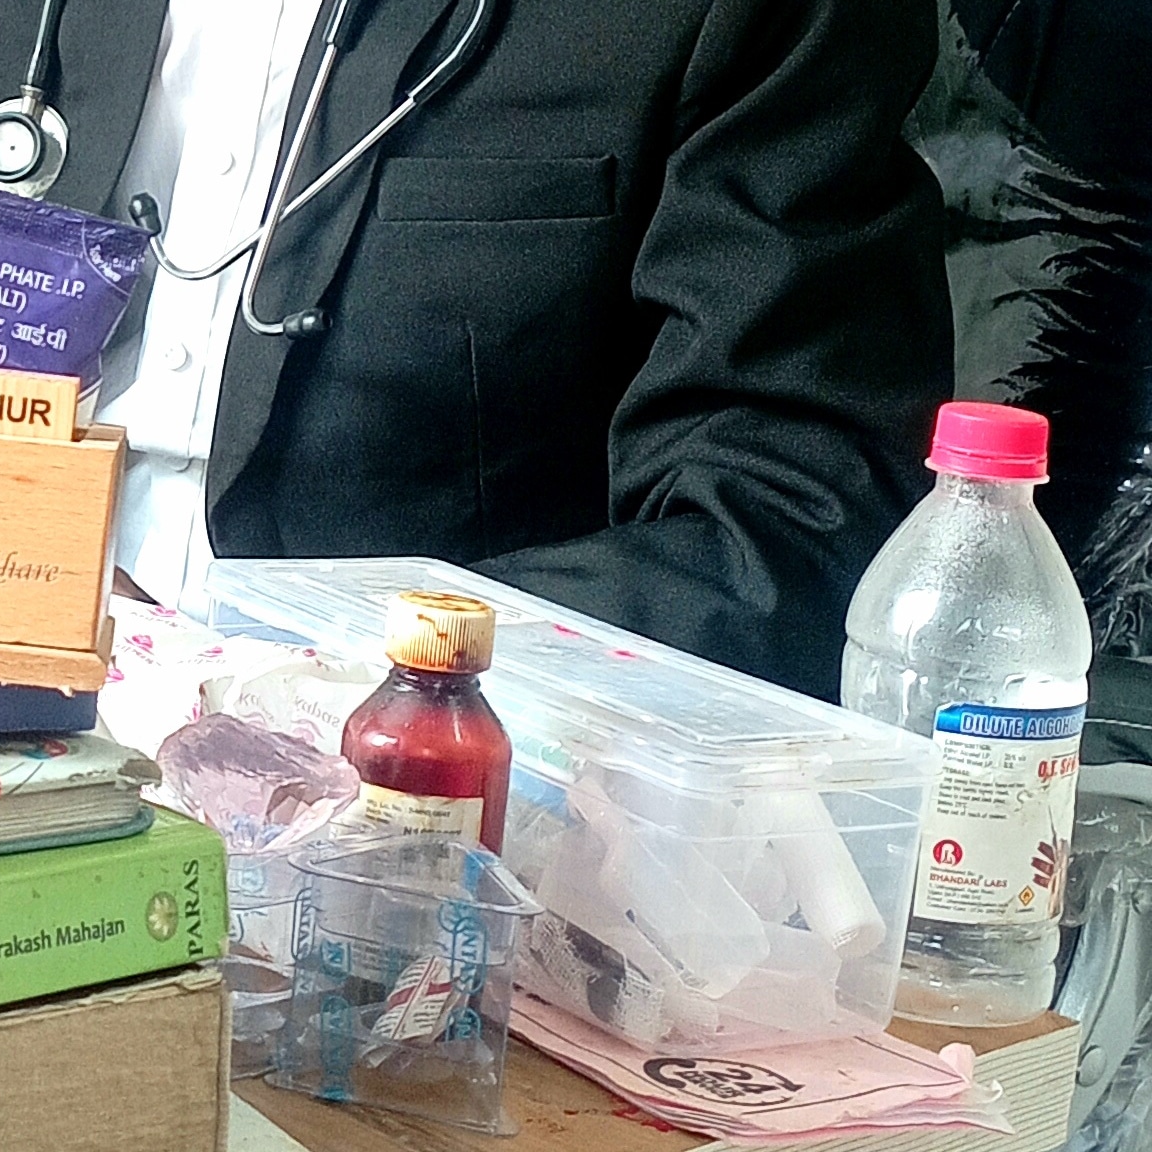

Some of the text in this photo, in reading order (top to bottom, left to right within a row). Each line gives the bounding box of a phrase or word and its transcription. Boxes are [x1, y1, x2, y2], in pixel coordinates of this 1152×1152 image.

[962, 713, 1024, 738] DILUTE
[929, 872, 980, 886] BHANDARI
[183, 858, 204, 958] PARAS
[55, 917, 126, 948] Mahajan
